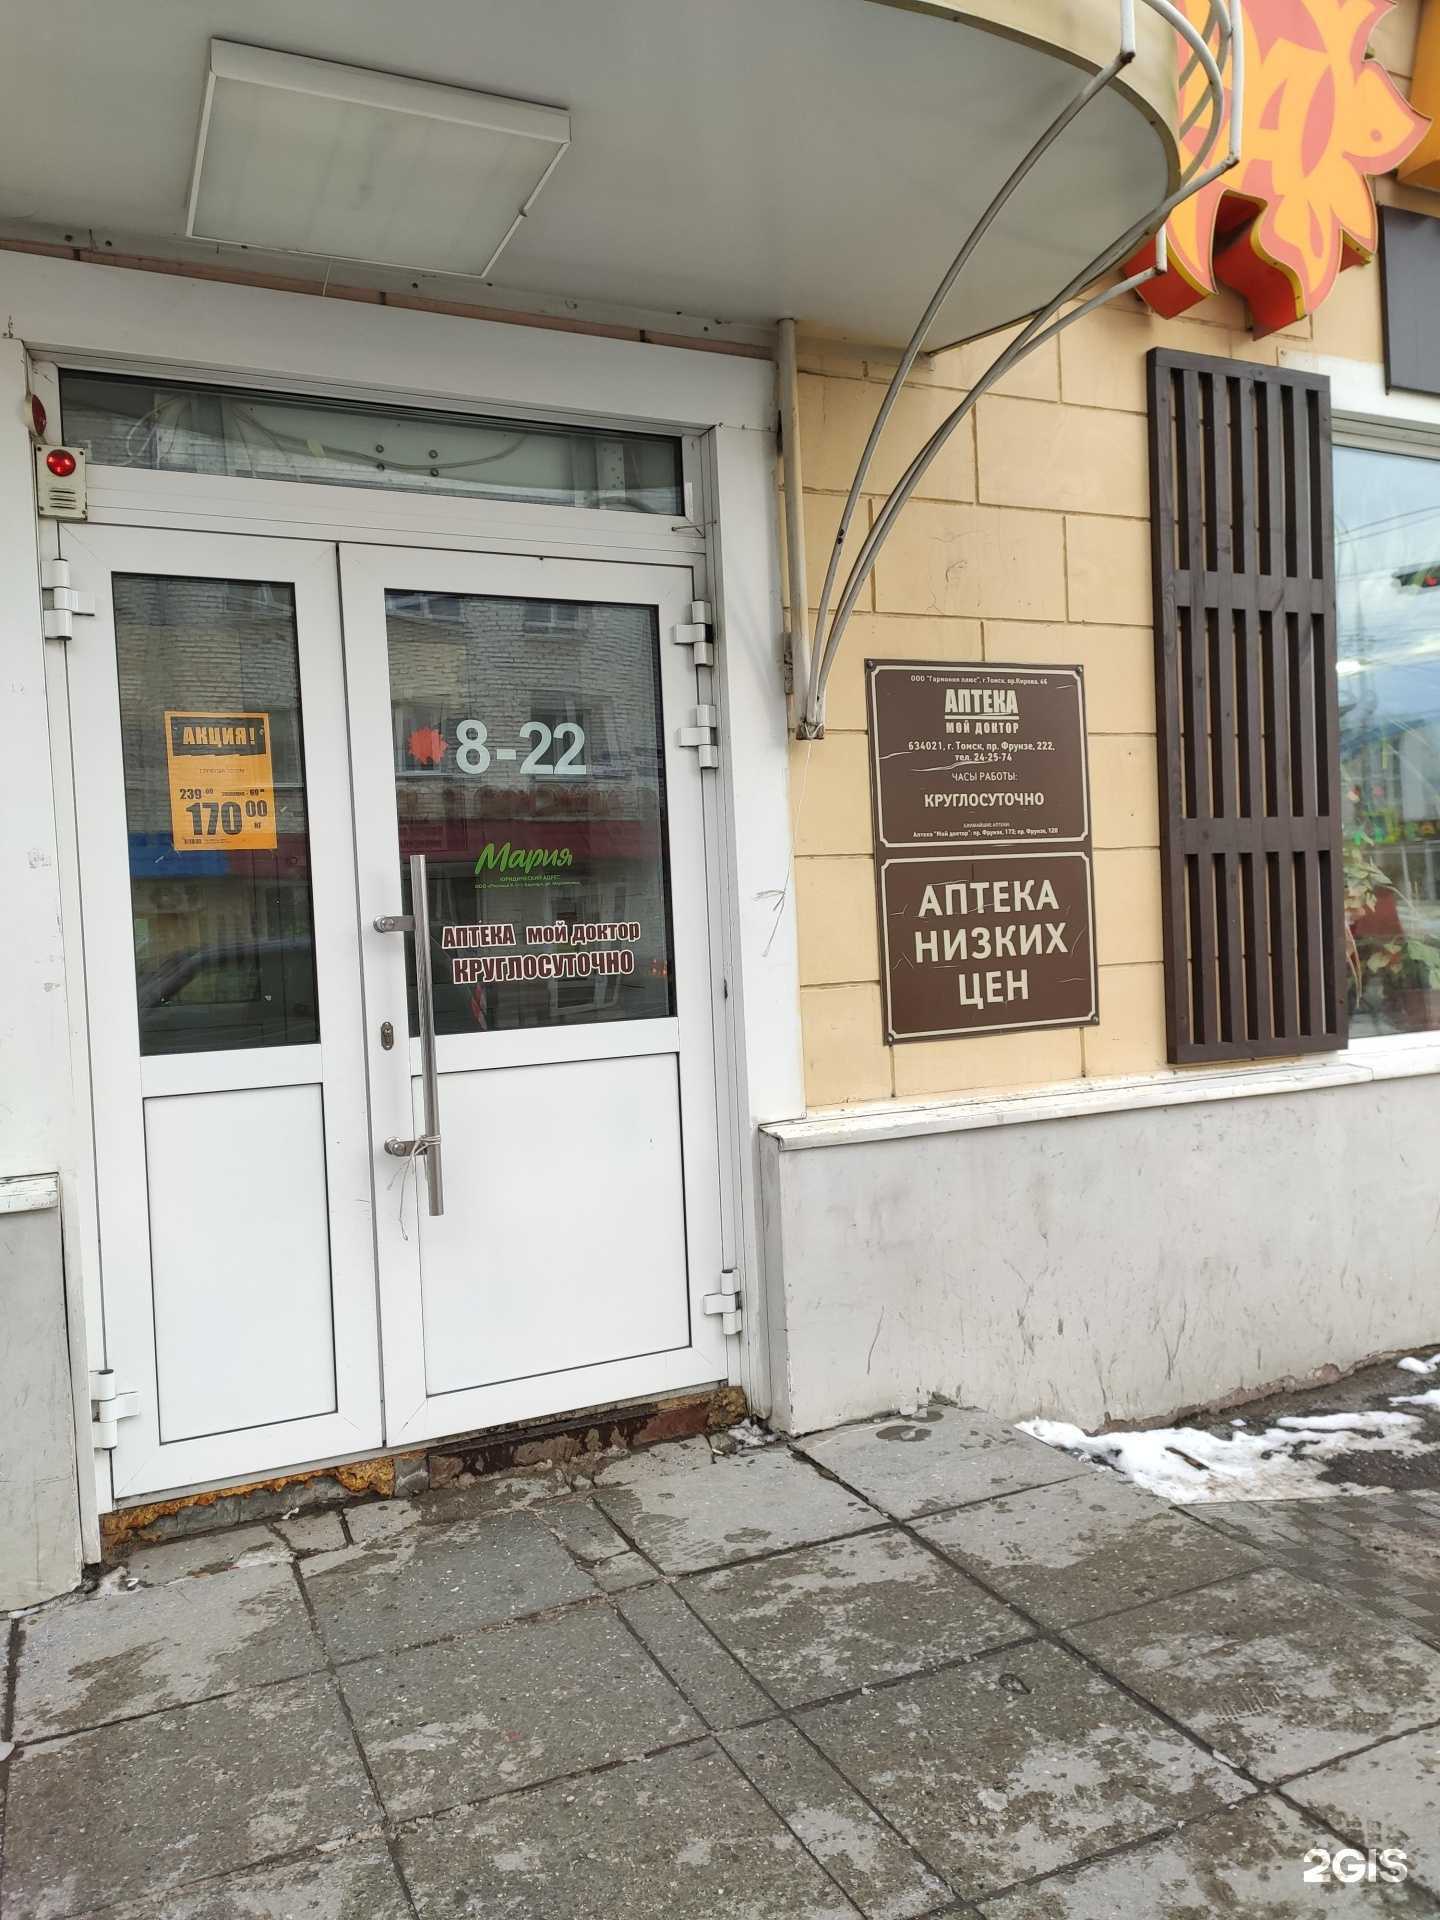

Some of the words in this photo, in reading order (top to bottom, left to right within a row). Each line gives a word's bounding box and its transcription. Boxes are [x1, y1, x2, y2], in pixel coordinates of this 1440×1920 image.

[944, 689, 1019, 714] АПТЕКА
[182, 726, 256, 748] АКЦИЯ!
[946, 720, 970, 734] МОЙ
[975, 722, 1019, 735] ДОКТОР
[455, 719, 587, 775] 8-22
[955, 753, 973, 761] тел.
[974, 753, 1012, 762] 24-25-74
[986, 743, 999, 751] пр.
[1001, 741, 1036, 752] Фрунзе,
[952, 772, 977, 782] ЧАСЫ
[979, 772, 1018, 781] РАБОТЫ:
[180, 788, 202, 800] 239
[924, 792, 1045, 808] КРУГЛОСУТОЧНО
[186, 801, 242, 835] 170
[245, 800, 268, 817] 00
[474, 842, 573, 875] Мария
[918, 879, 1060, 918] АПТЕКА
[442, 923, 516, 949] АПТЕКА
[914, 922, 1069, 963] НИЗКИХ
[453, 950, 635, 985] КРУГЛОСУТОЧНО
[958, 969, 1029, 1010] ЦЕН
